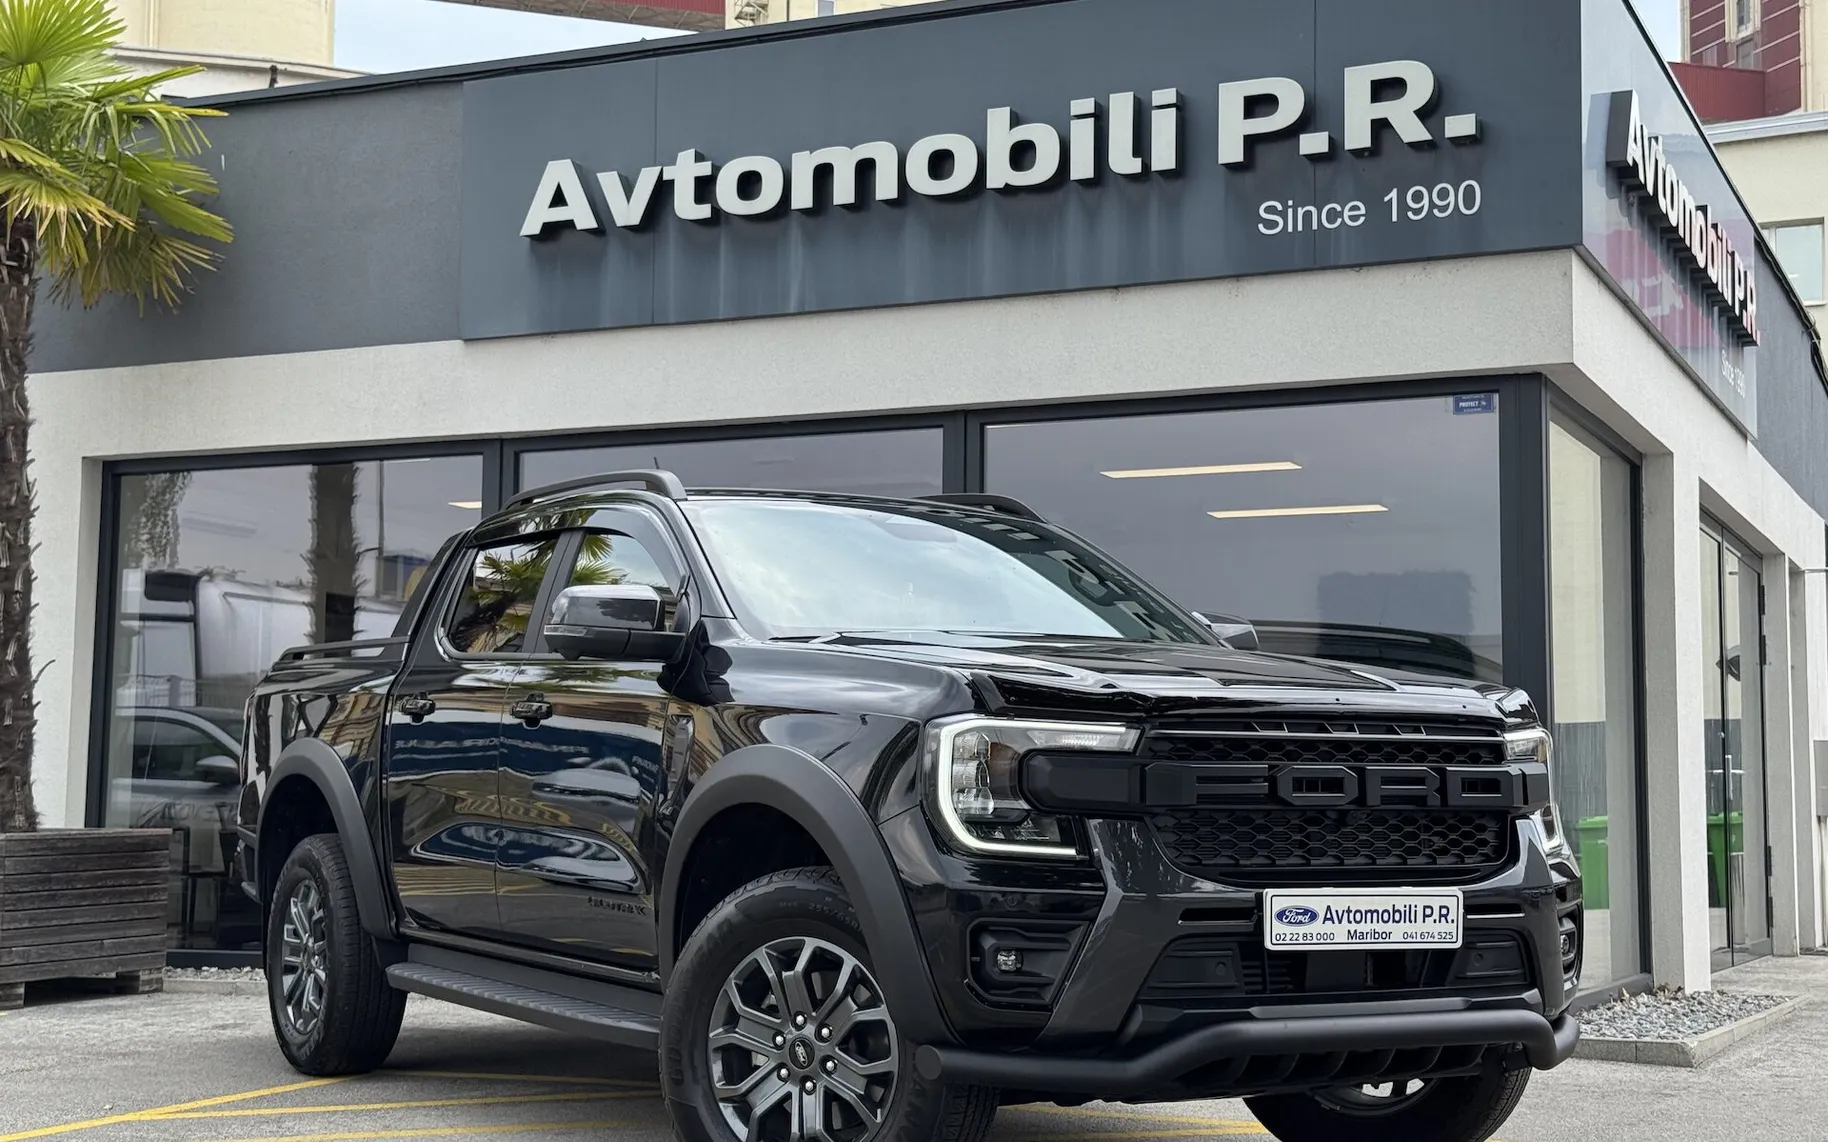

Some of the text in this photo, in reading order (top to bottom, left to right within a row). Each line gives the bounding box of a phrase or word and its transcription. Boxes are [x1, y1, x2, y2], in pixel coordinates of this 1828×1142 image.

[520, 60, 1478, 237] Avtomobili P.R.
[1257, 179, 1482, 235] Since 1990
[1625, 89, 1761, 347] Avtomobili P.R.
[1146, 763, 1524, 807] FORD
[1279, 907, 1314, 926] Ford
[1322, 904, 1455, 925] Avtomobili P.R.
[1302, 932, 1314, 942] 83
[1316, 931, 1335, 942] 000
[1347, 929, 1393, 941] Maribor
[1403, 931, 1454, 941] 041 674 525
